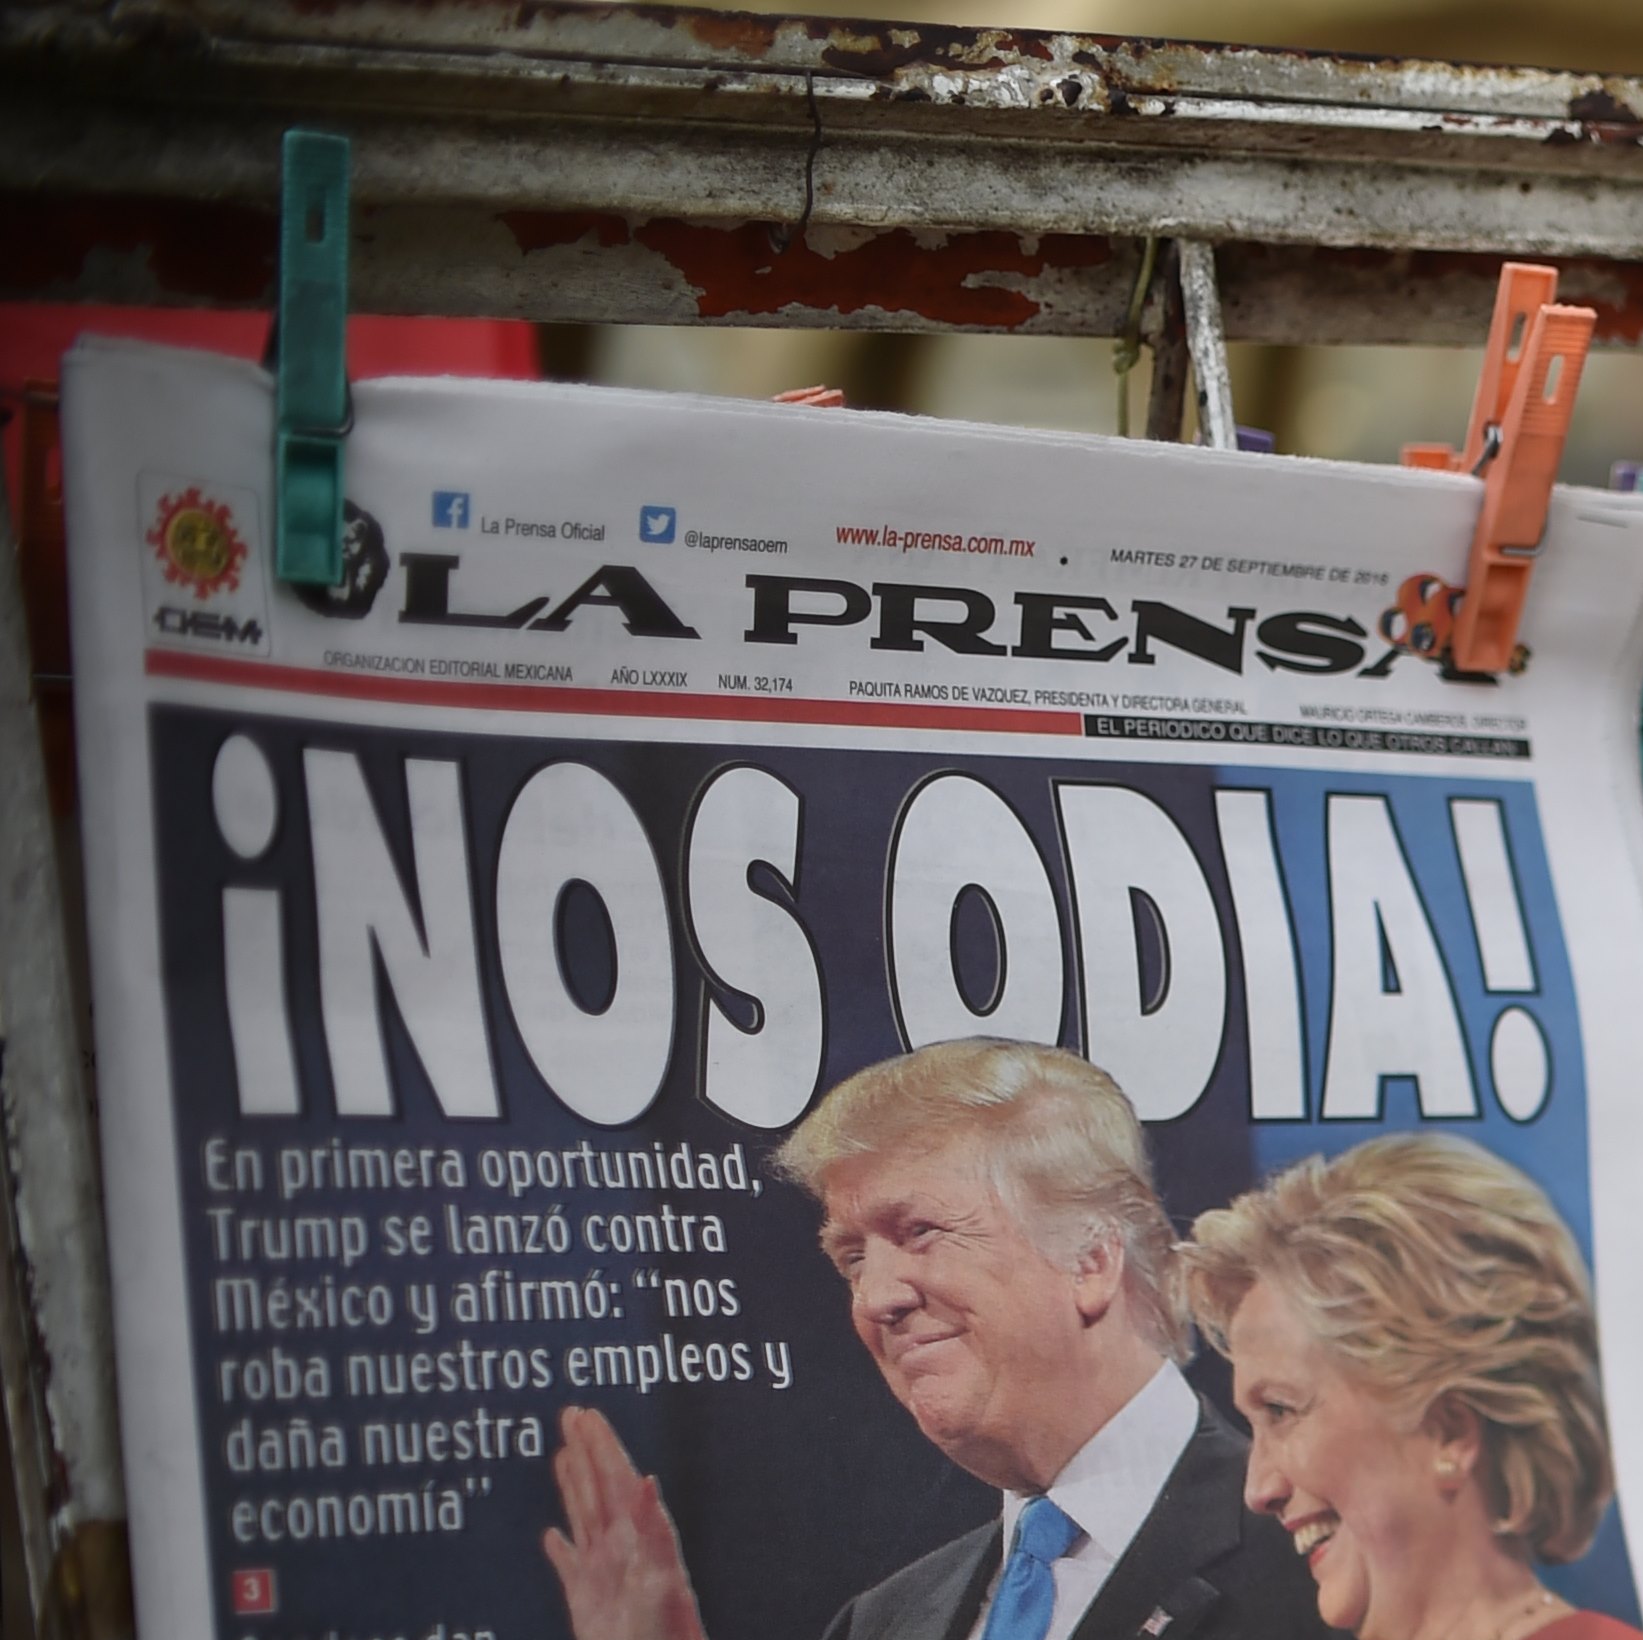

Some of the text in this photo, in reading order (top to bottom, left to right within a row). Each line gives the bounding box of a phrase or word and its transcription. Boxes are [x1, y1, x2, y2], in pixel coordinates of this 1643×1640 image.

[481, 517, 605, 540] La Prensa Oficial
[684, 531, 788, 554] @laprensaoem
[836, 525, 1035, 558] www.la-prensa.com.mx
[1110, 549, 1324, 581] MARTES 27 DE SEPTIEMBRE
[398, 552, 702, 639] LA
[324, 650, 573, 682] ORGANIZACION EDITORIAL MEXICANA
[610, 666, 688, 688] AÑO LXXXIX
[718, 674, 793, 694] NUM. 32,174
[849, 680, 1248, 716] PAQUITA RAMOS DE VAZQUEZ, PRESIDENTA DIRECTORA GENERAL
[1097, 718, 1446, 753] EL PERIODICO QUE DICE QUE OTROS
[211, 733, 1552, 1130] ¡NOS ODIA!
[205, 1139, 764, 1199] En primera oportunidad,
[207, 1204, 728, 1265] Trump se lanzó contra
[215, 1277, 392, 1332] México
[410, 1291, 438, 1334] y
[454, 1270, 622, 1322] afirmó:
[220, 1334, 793, 1401] roba nuestros empleos y
[226, 1408, 544, 1472] daña nuestra
